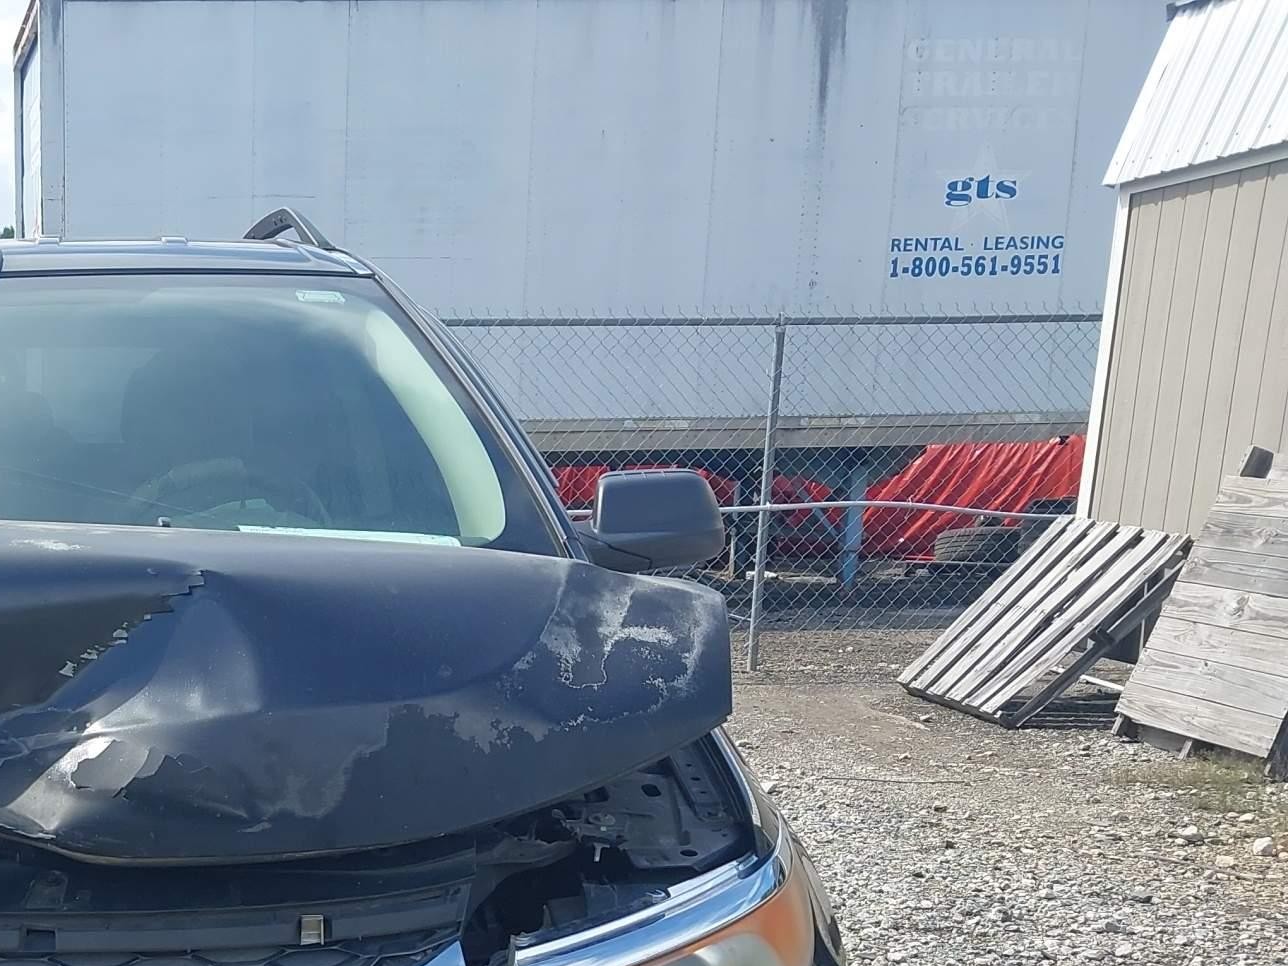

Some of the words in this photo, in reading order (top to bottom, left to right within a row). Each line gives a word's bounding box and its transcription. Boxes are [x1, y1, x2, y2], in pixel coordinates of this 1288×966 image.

[906, 36, 1081, 63] GENERAL
[945, 174, 1017, 207] gts
[890, 237, 964, 252] RENTAL
[983, 235, 1064, 251] LEASING
[889, 254, 1060, 278] 1-800-561-9551
